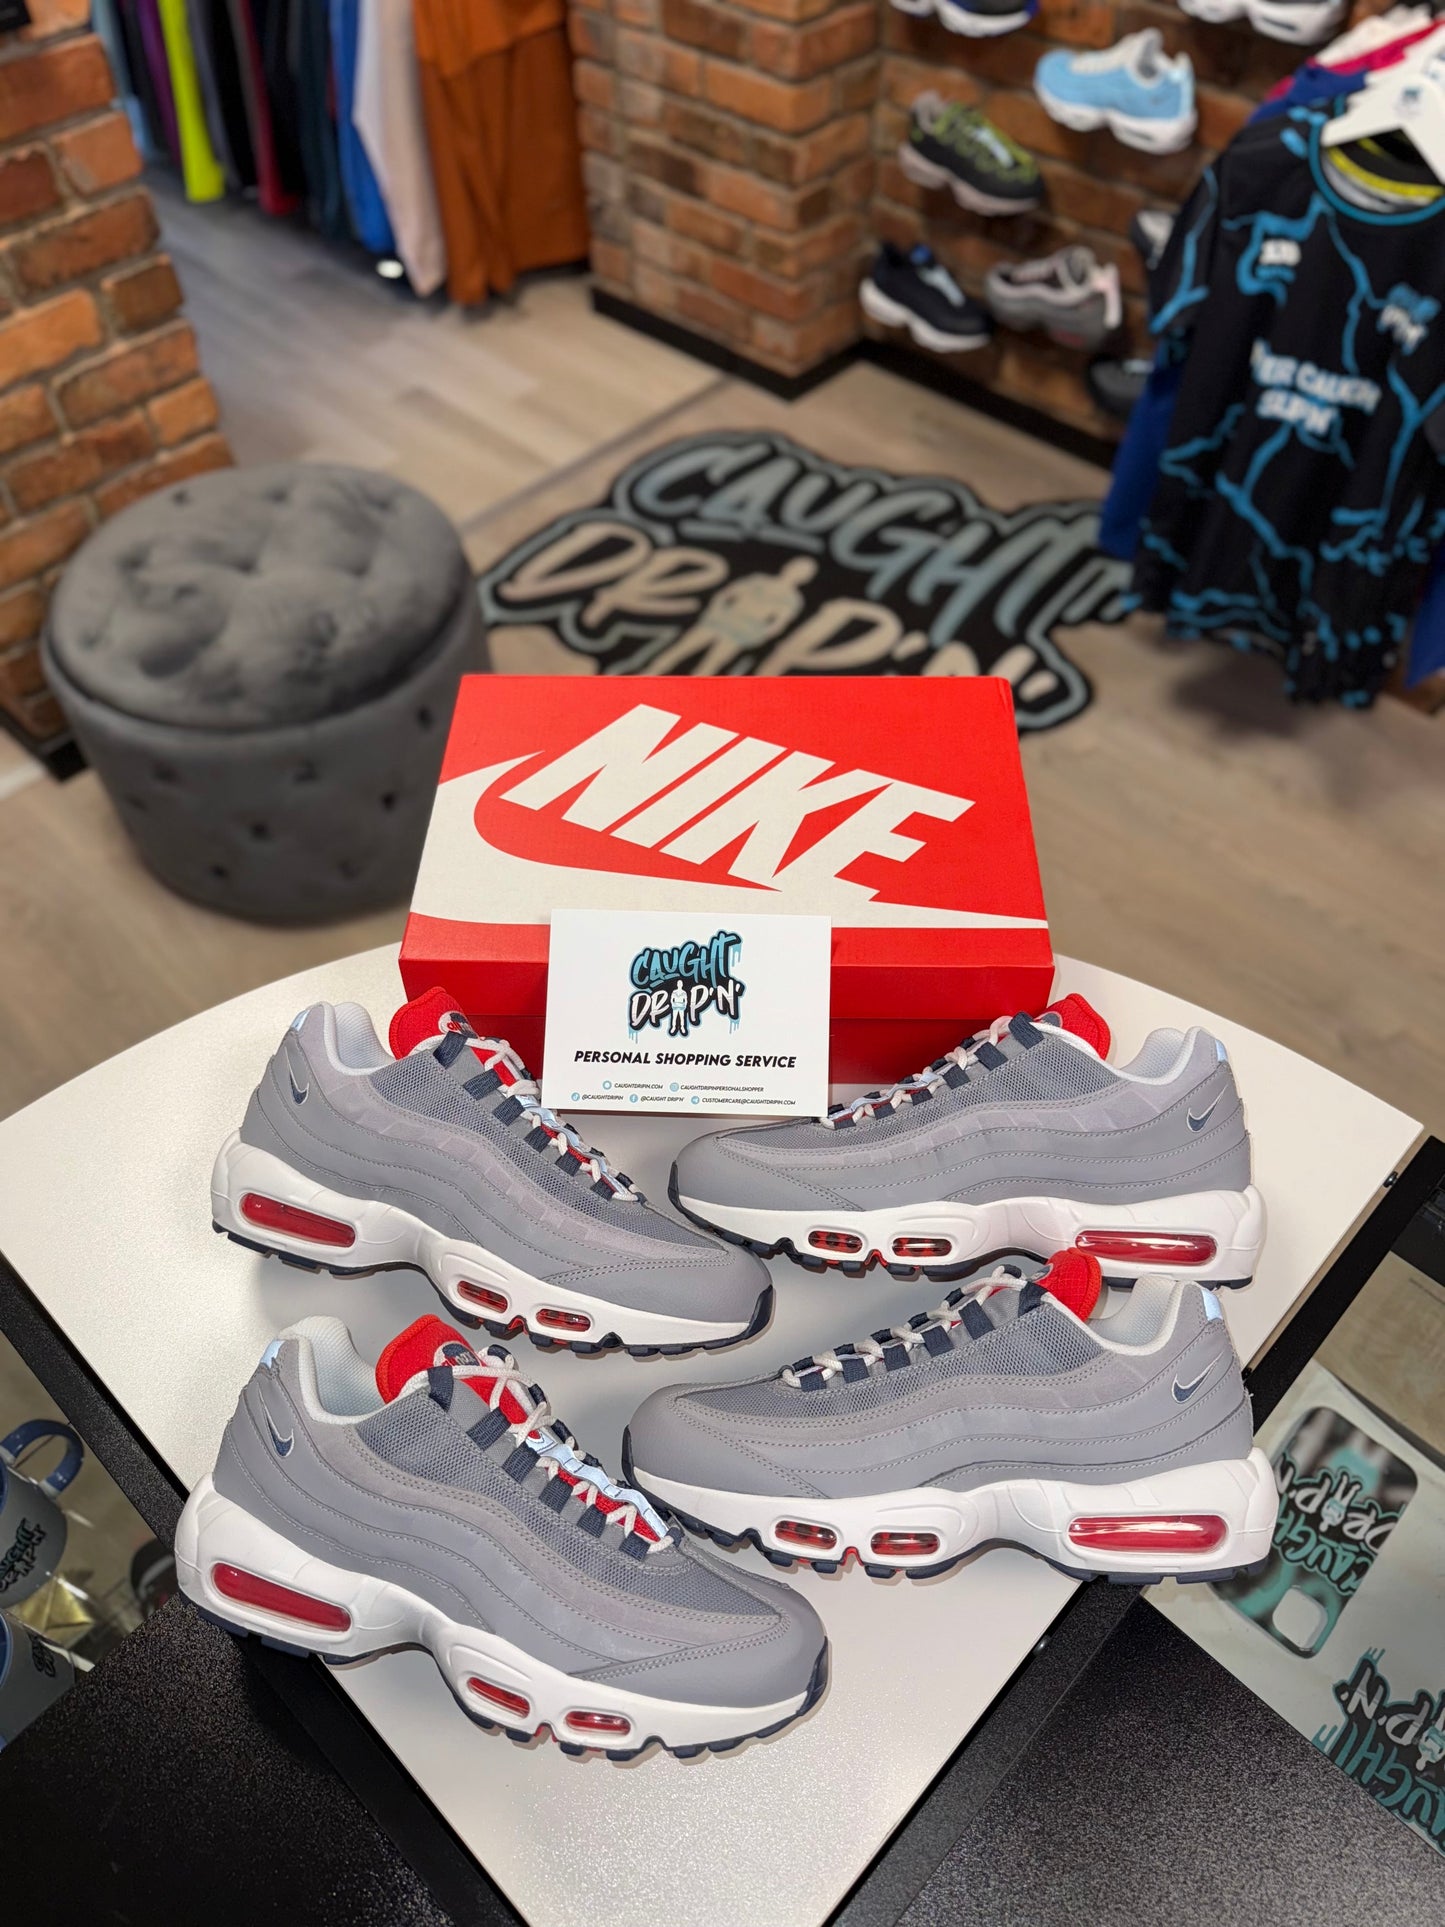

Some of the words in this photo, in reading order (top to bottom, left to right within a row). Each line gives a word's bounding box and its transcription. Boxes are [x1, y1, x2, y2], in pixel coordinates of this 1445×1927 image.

[499, 703, 977, 903] NIKE
[631, 931, 738, 988] CAUGHT
[574, 1050, 651, 1064] PERSONAL
[655, 1053, 731, 1067] SHOPPING
[735, 1055, 797, 1068] SERVICE
